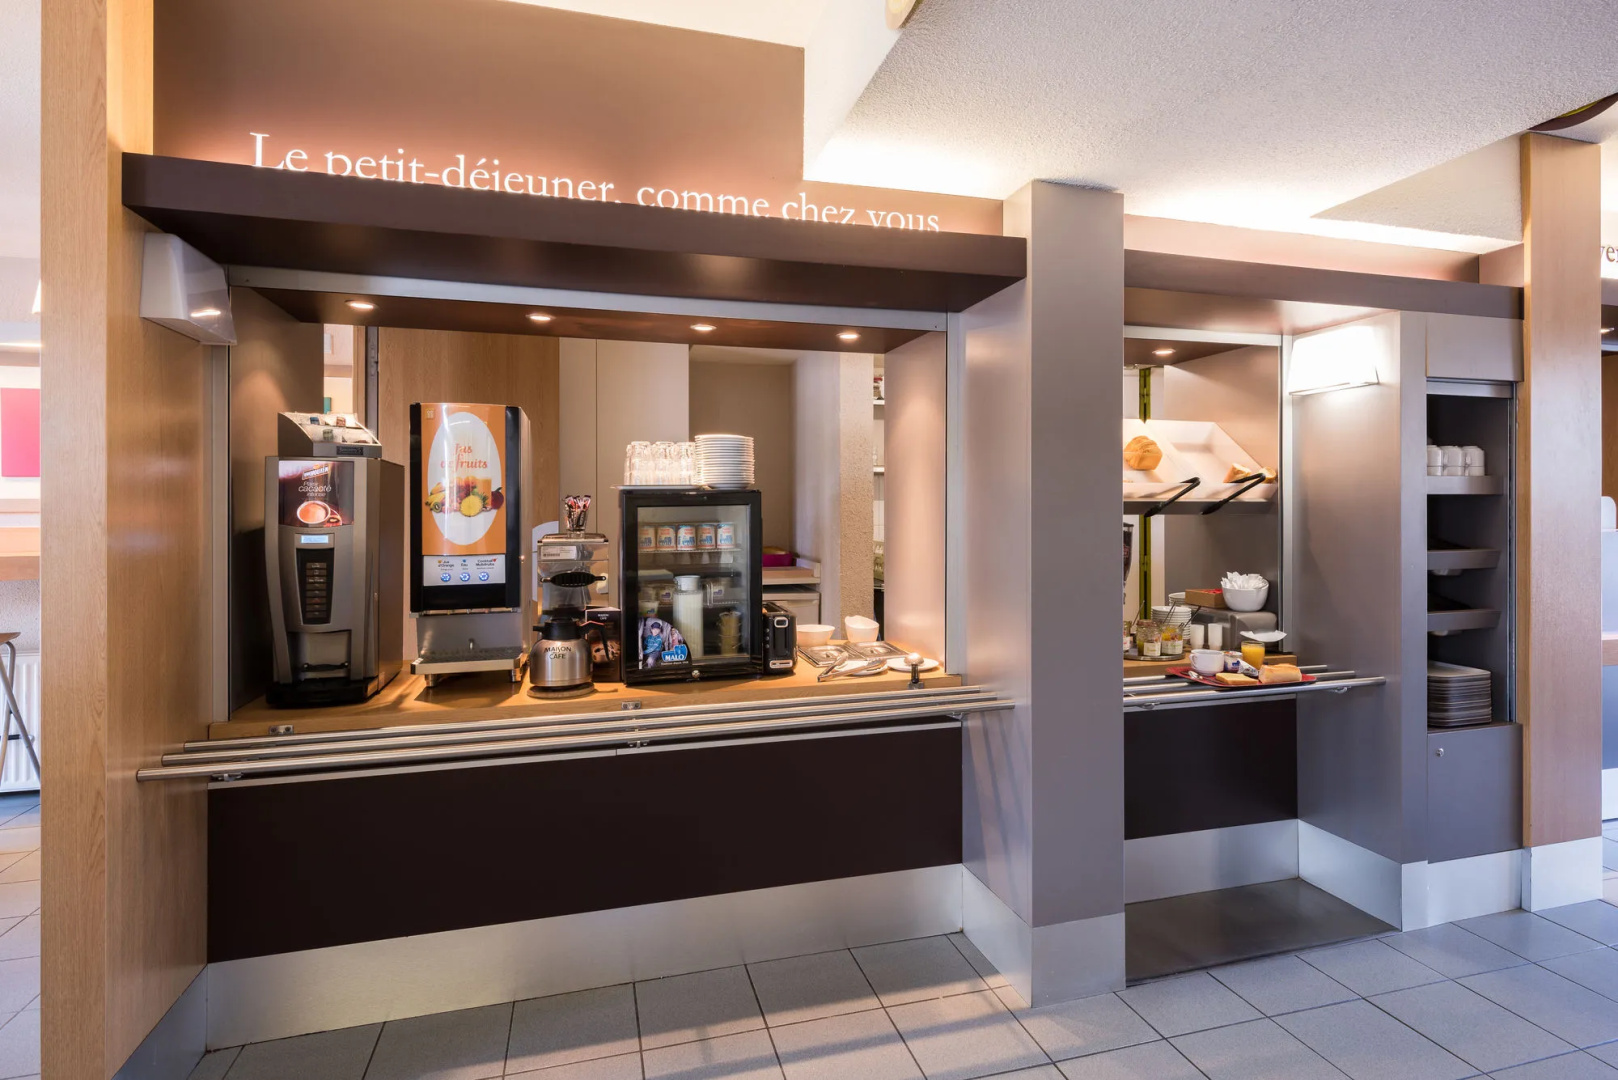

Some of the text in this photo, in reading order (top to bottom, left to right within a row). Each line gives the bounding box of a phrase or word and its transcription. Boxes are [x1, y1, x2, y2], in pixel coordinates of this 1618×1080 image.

[249, 132, 308, 172] Le
[636, 186, 770, 217] comme
[781, 192, 856, 225] chez
[866, 208, 940, 232] vous
[455, 453, 488, 473] fruits
[664, 653, 685, 661] MALO
